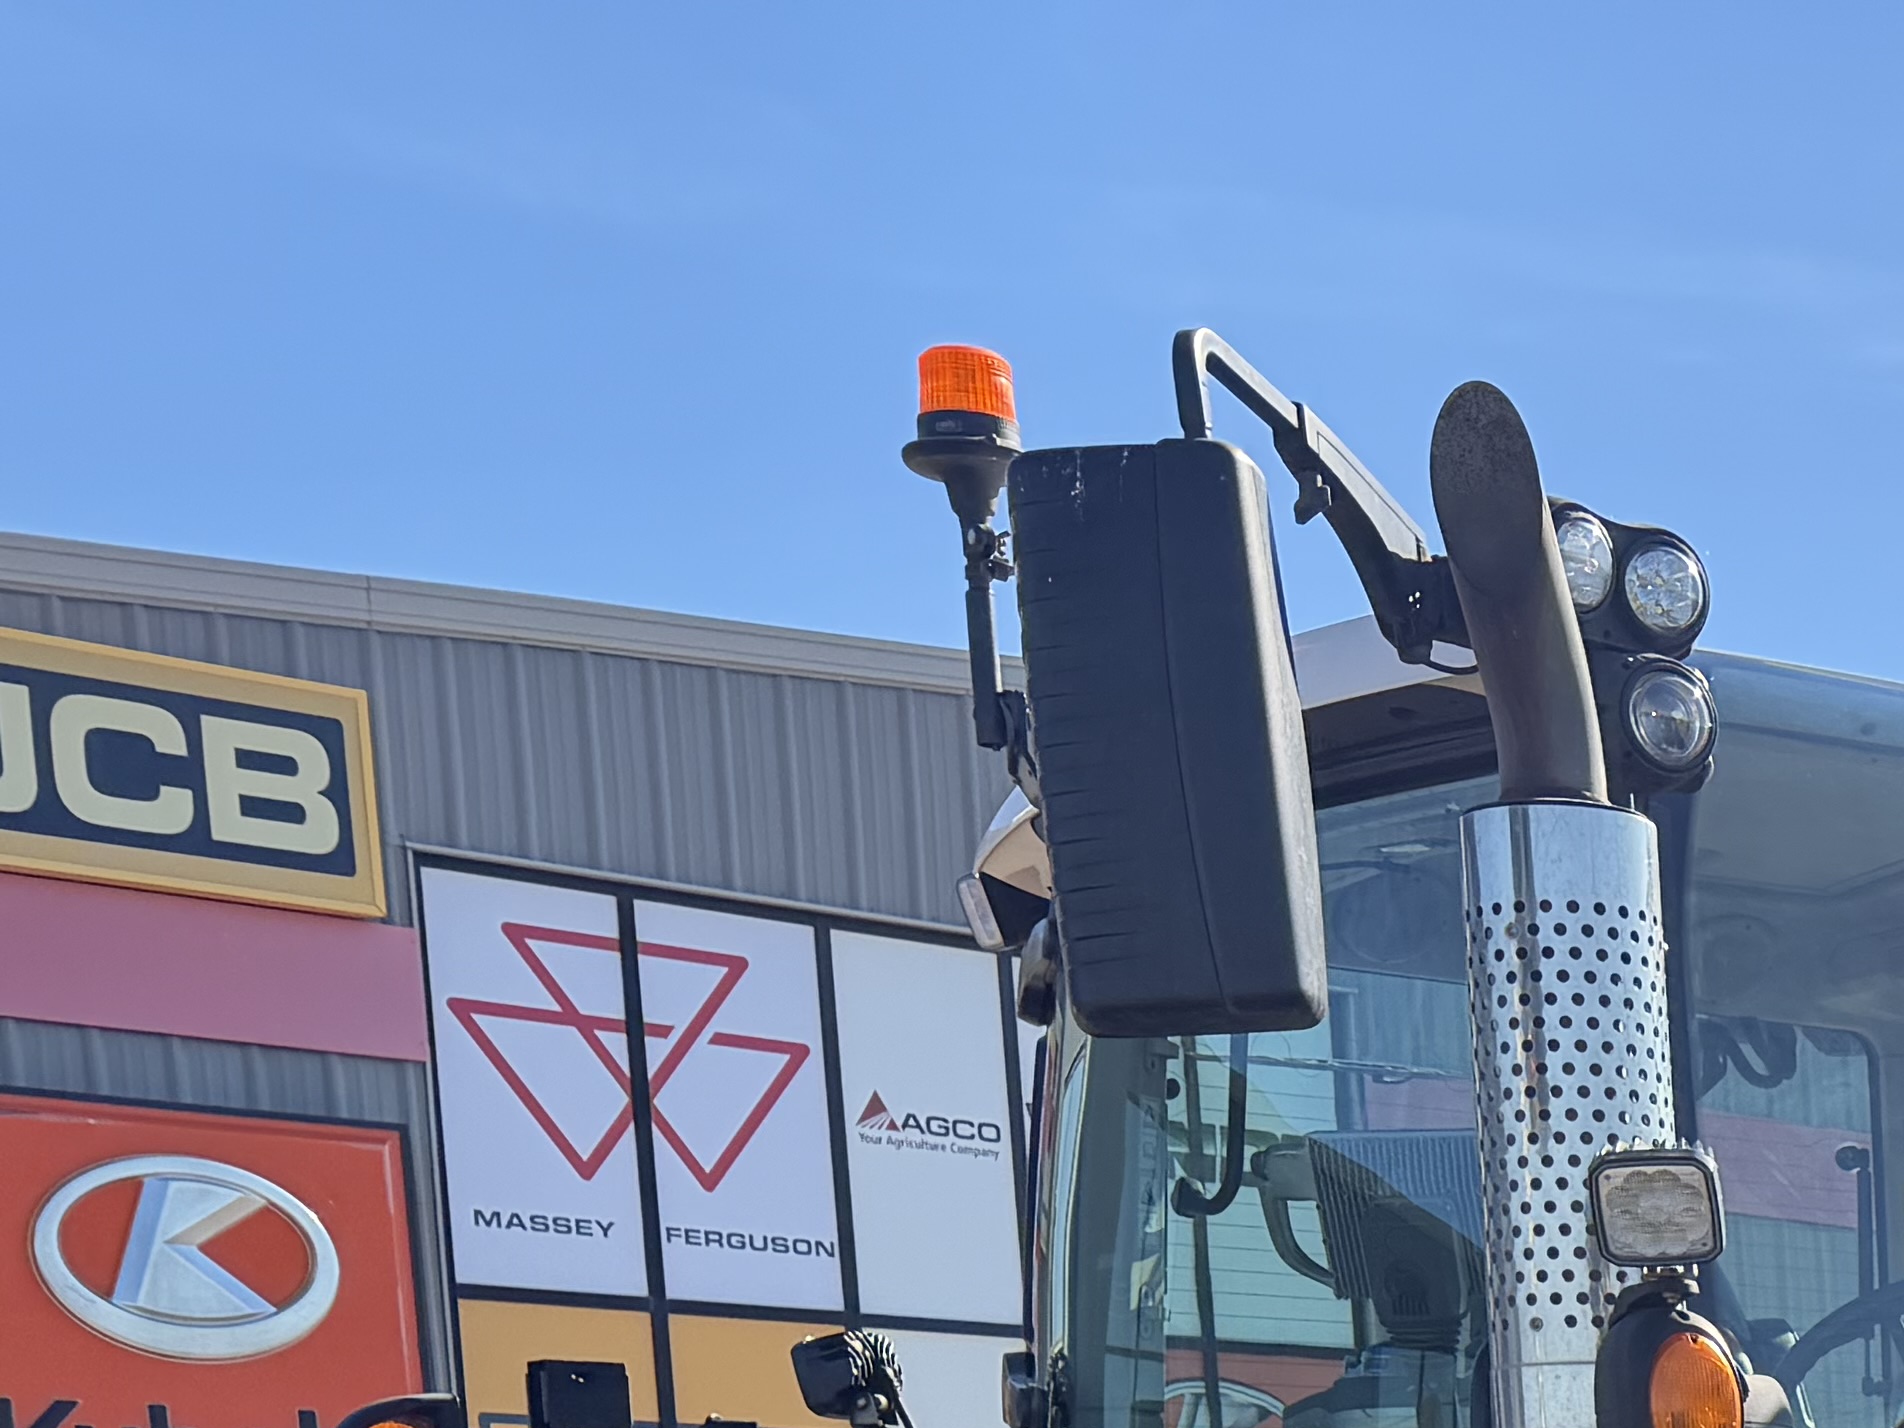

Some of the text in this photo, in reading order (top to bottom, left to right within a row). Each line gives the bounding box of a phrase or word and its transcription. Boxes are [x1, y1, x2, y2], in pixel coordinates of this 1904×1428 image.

[901, 1112, 1001, 1143] AGCO
[858, 1132, 1000, 1162] Your Agriculture Company
[472, 1208, 836, 1259] MASSEY FERGUSON
